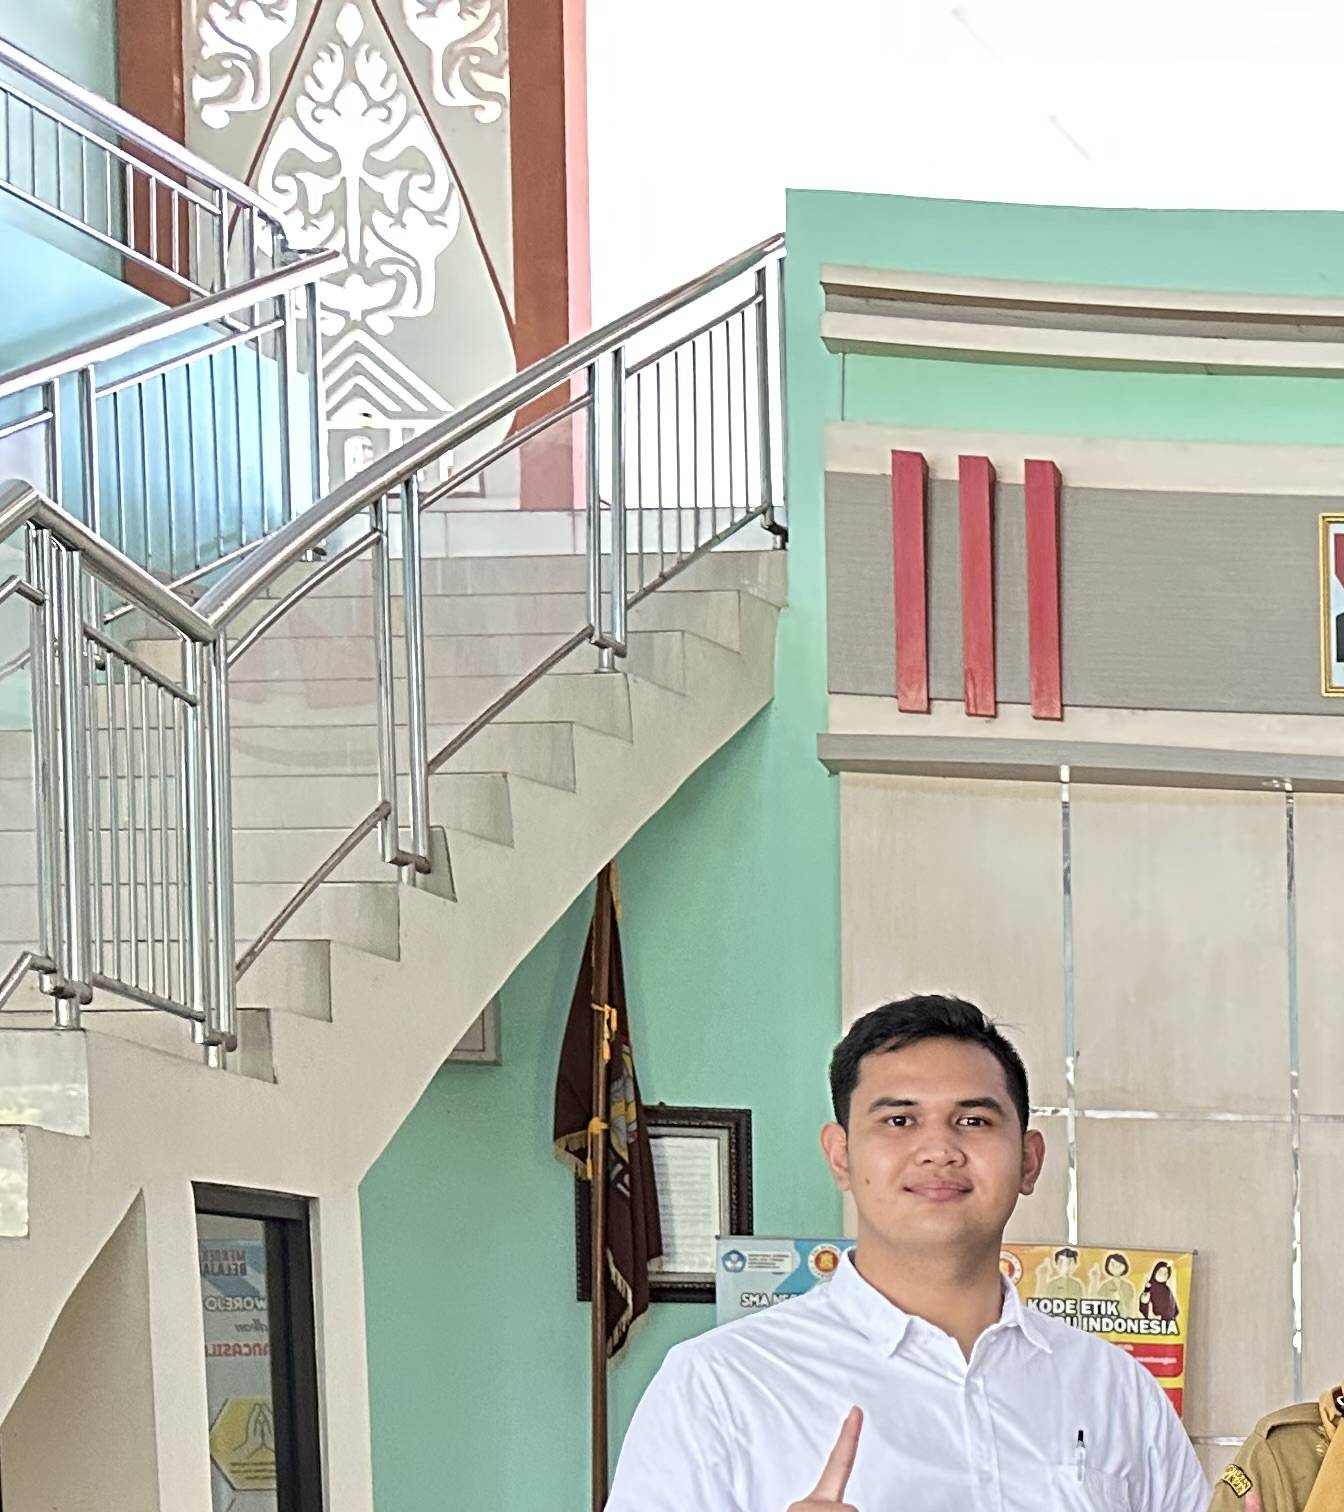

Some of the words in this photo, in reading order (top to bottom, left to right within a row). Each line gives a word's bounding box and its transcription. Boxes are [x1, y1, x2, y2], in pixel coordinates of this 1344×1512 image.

[740, 1292, 770, 1308] SMA
[1027, 1298, 1077, 1316] KODE
[1080, 1300, 1120, 1317] ETIK
[1083, 1318, 1180, 1335] INDONESIA
